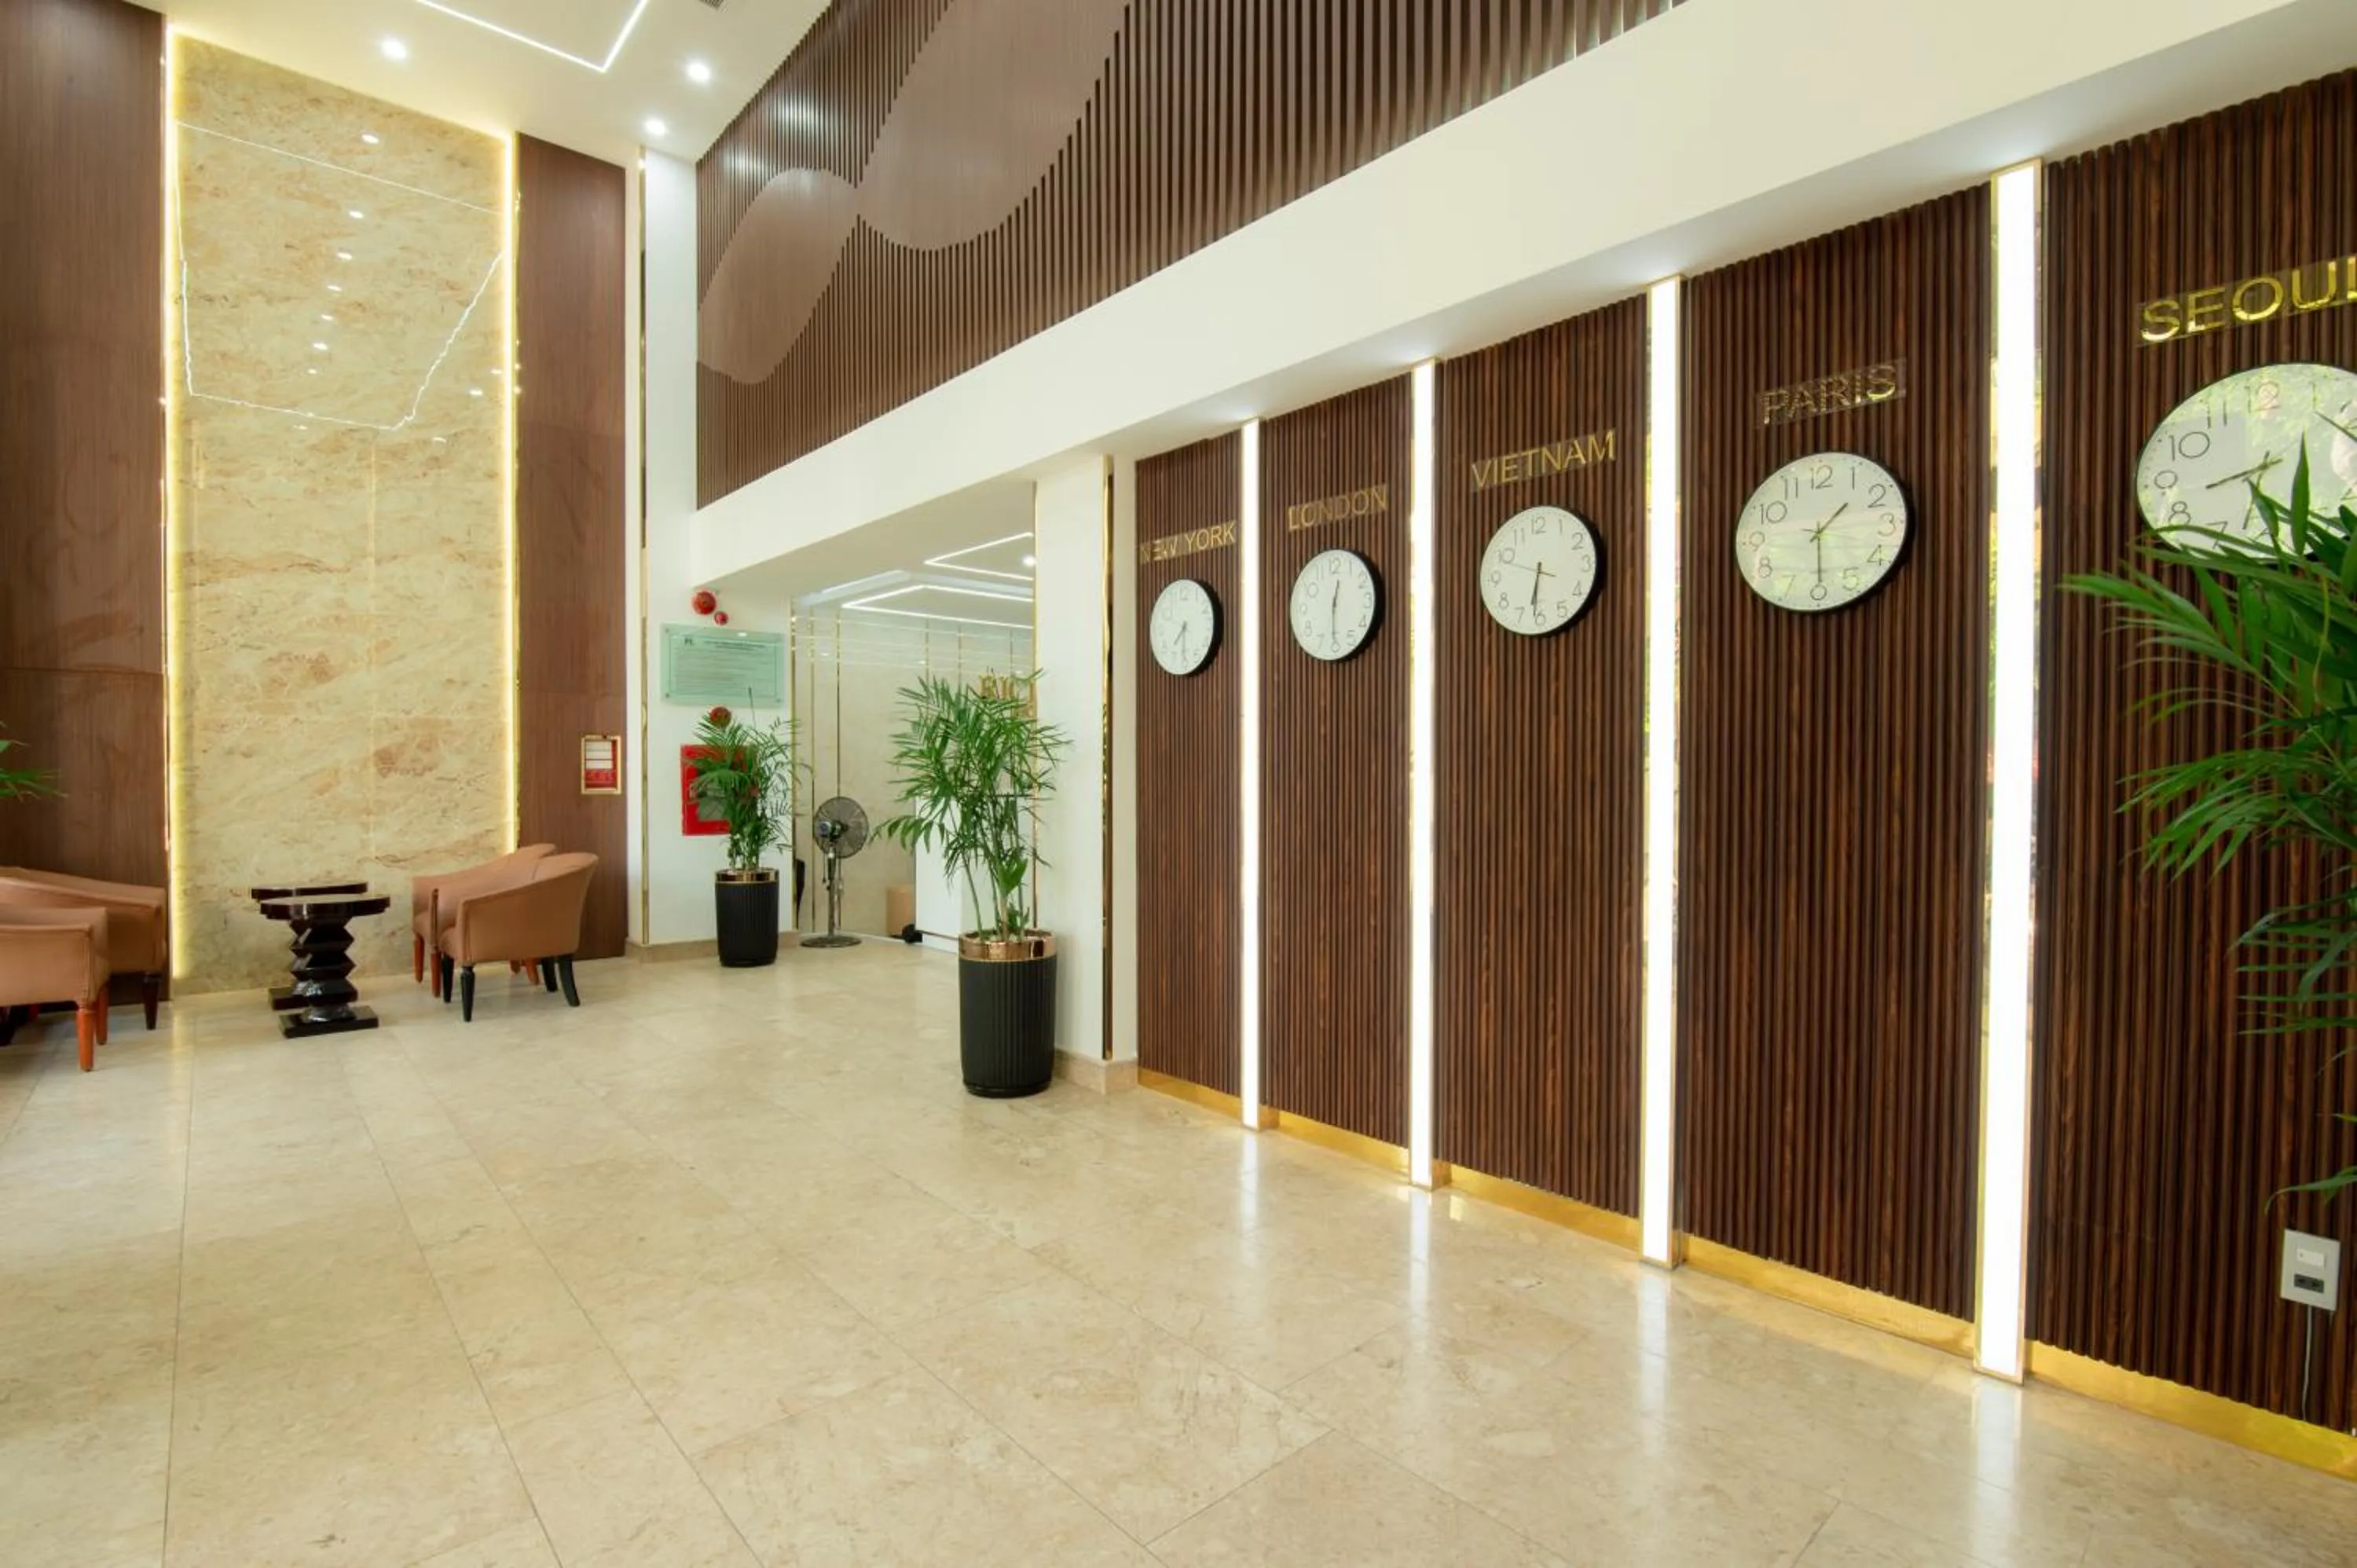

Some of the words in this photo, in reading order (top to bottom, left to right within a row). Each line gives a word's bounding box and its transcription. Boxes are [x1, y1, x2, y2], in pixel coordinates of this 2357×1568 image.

[1761, 365, 1896, 424] PARIS
[2207, 401, 2227, 428] 11
[2169, 431, 2210, 460] 10
[1472, 430, 1615, 488] VIETNAM
[1781, 475, 1798, 500] 11
[1811, 465, 1833, 489] 12
[1869, 484, 1886, 508] 2
[1288, 485, 1387, 531] LONDON
[1761, 500, 1787, 525] 10
[1513, 528, 1524, 545] 11
[1531, 517, 1546, 534] 12
[1878, 514, 1896, 537] 3
[1140, 537, 1178, 564] NEW
[1186, 522, 1236, 553] YORK
[1571, 532, 1583, 550] 2
[1750, 531, 1765, 551] 9
[1498, 548, 1515, 564] 10
[1582, 555, 1591, 572] 3
[1868, 544, 1883, 566] 4
[1490, 571, 1501, 587] 9
[1758, 557, 1772, 579] 8
[1842, 567, 1859, 591] 5
[1573, 581, 1582, 596] 4
[1499, 592, 1509, 609] 8
[1557, 602, 1567, 617] 5
[1516, 607, 1524, 623] 7
[1535, 610, 1545, 626] 6
